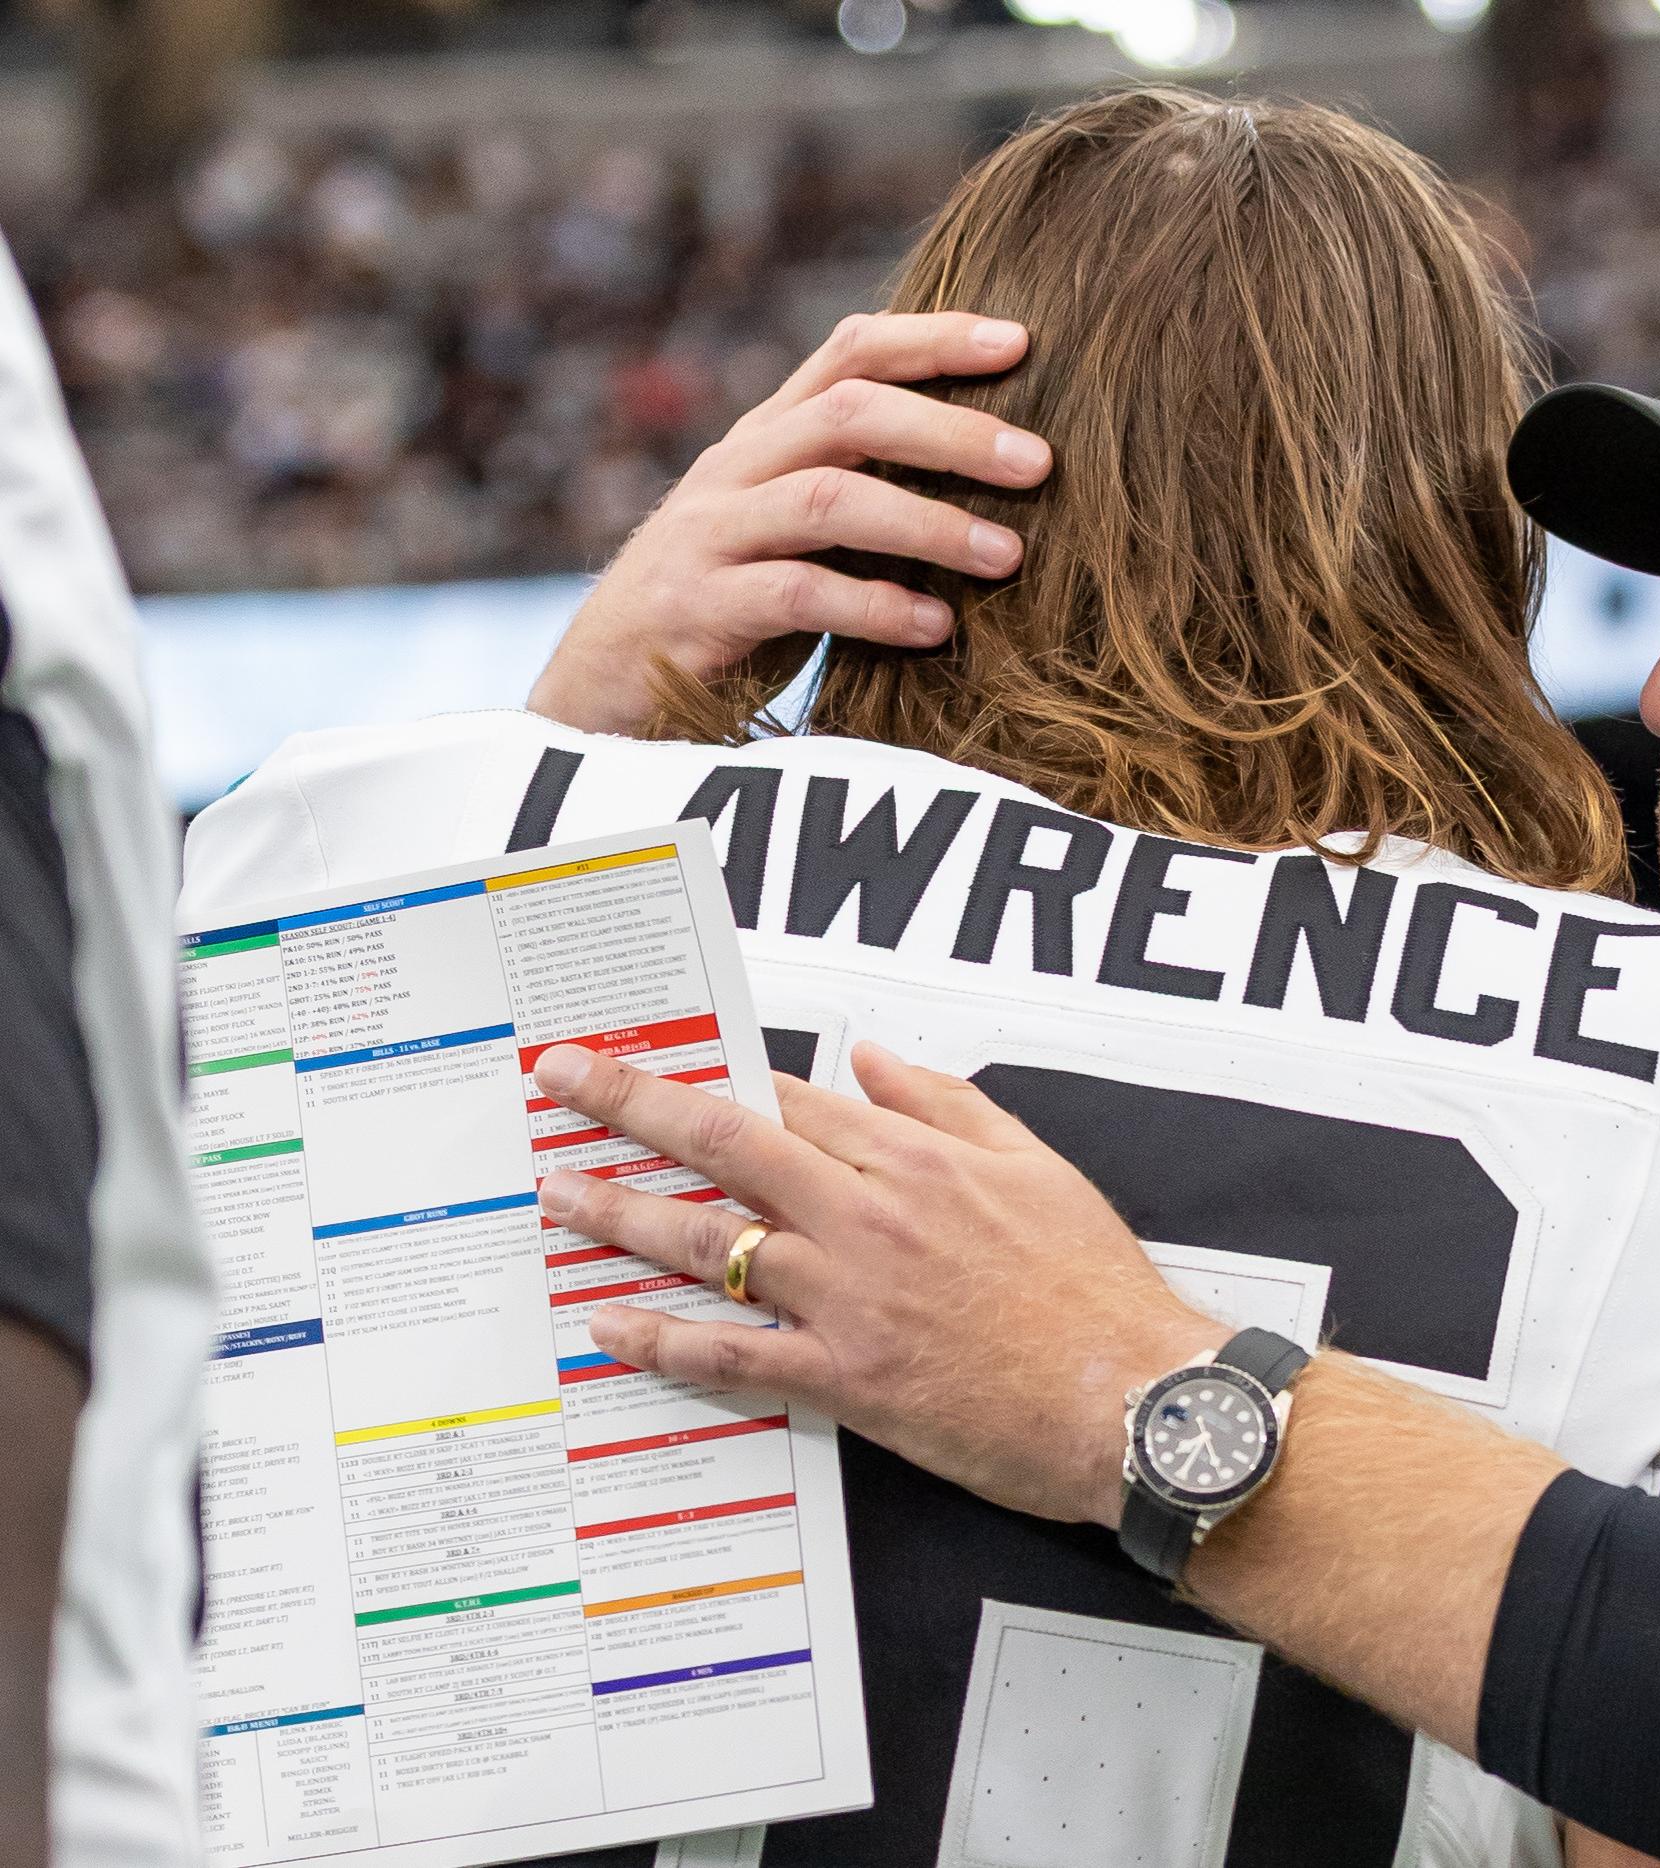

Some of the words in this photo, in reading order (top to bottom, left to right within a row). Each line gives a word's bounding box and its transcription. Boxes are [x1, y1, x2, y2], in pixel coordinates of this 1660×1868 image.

[324, 937, 340, 946] RUN
[364, 929, 382, 939] PASS
[325, 950, 341, 959] RUN
[366, 942, 384, 952] PASS
[337, 961, 353, 971] RUN
[377, 953, 395, 963] PASS
[338, 974, 354, 984] RUN
[379, 966, 397, 976] PASS
[332, 989, 348, 998] RUN
[373, 980, 391, 991] PASS
[351, 998, 367, 1008] RUN
[392, 990, 410, 1000] PASS
[370, 1007, 388, 1017] PASS
[328, 1029, 343, 1038] RUN
[366, 1022, 383, 1031] PASS
